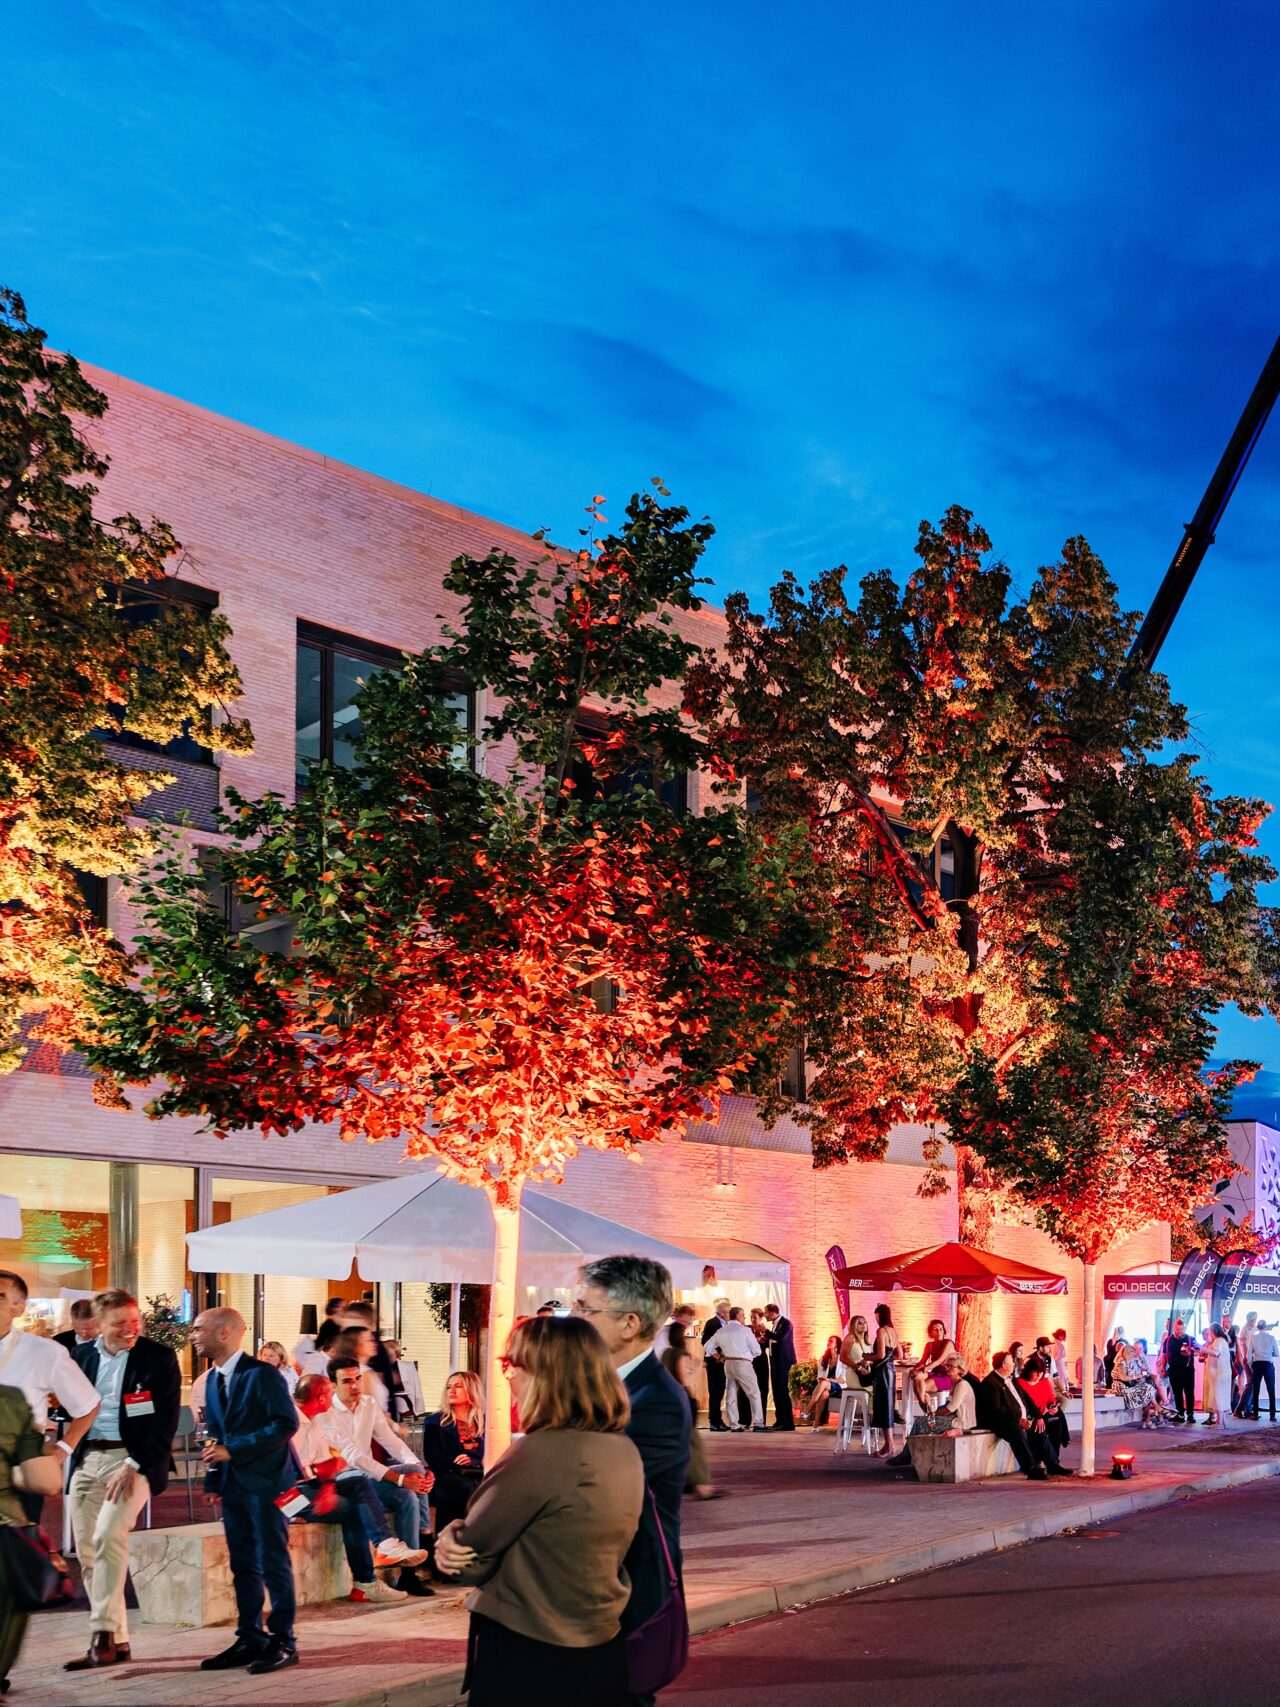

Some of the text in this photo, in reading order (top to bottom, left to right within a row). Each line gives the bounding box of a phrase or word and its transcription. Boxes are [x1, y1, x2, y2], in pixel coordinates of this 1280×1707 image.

[849, 1279, 863, 1288] BER
[1108, 1282, 1171, 1293] GOLDBECK
[1222, 1256, 1250, 1316] GOLDBECK
